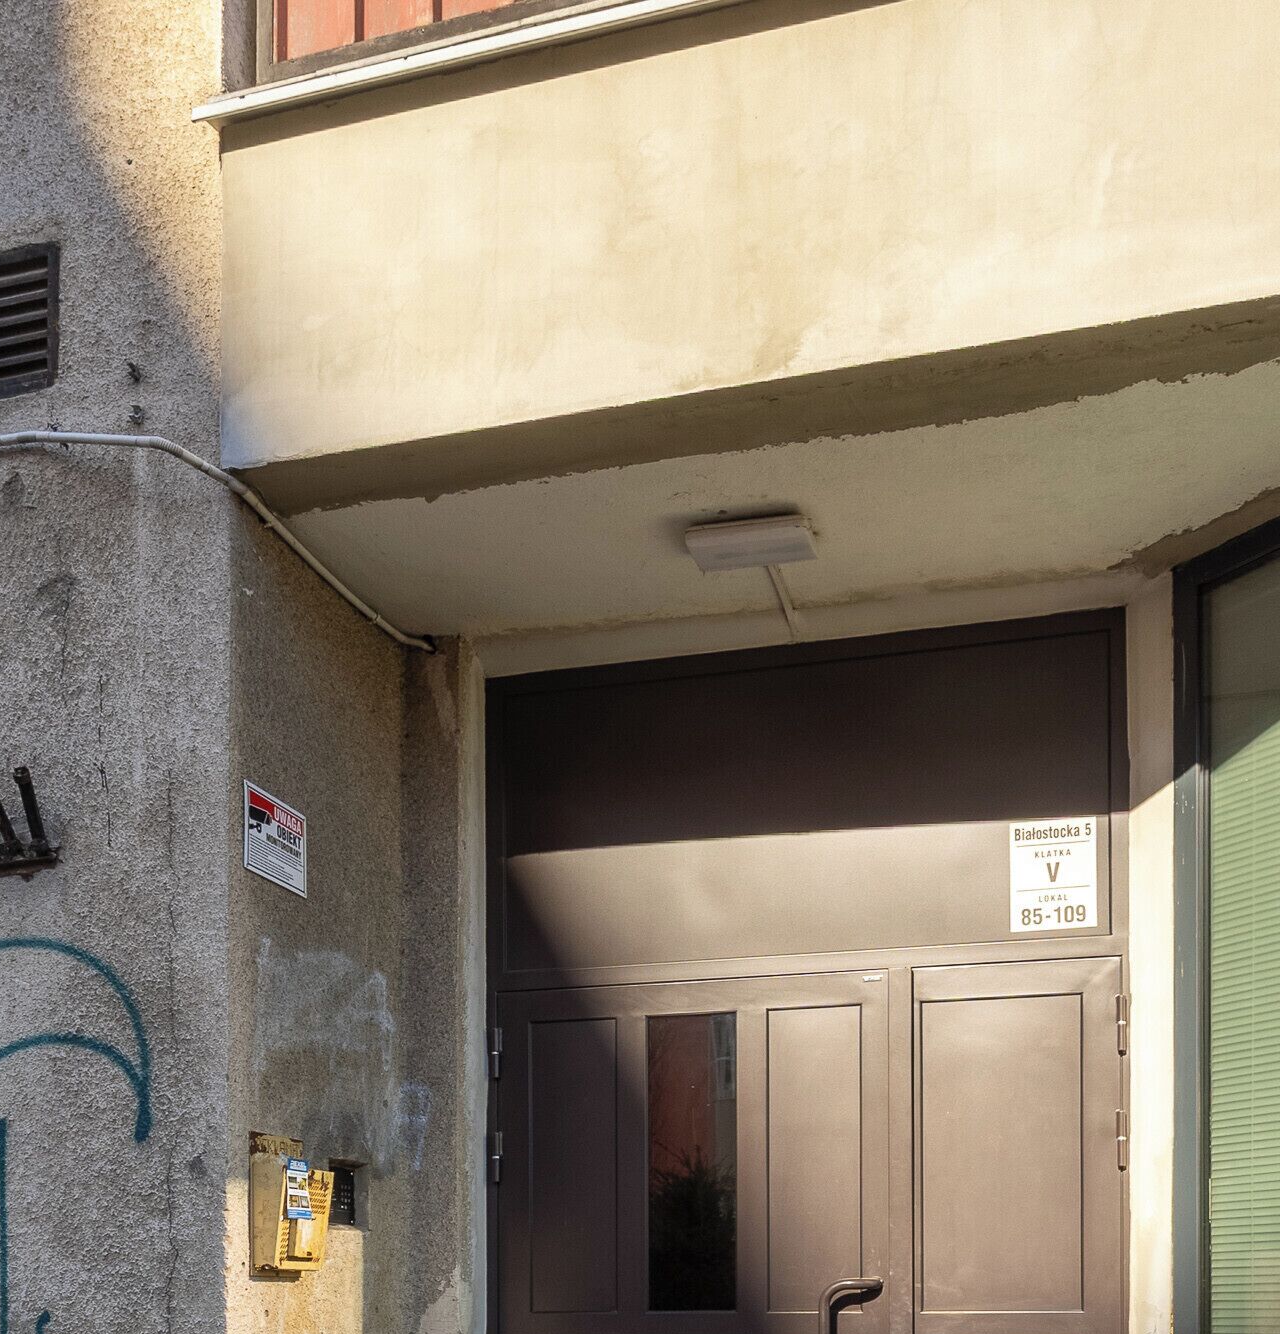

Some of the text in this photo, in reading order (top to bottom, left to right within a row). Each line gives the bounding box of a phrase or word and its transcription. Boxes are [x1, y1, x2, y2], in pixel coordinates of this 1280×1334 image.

[273, 806, 302, 835] UWAGA
[276, 824, 302, 849] OBIEKT
[1014, 822, 1091, 842] Białostocka 5
[1034, 848, 1072, 858] KLATKA
[1046, 862, 1060, 882] V
[1038, 894, 1068, 903] LOKAL
[1021, 904, 1087, 926] 85-109
